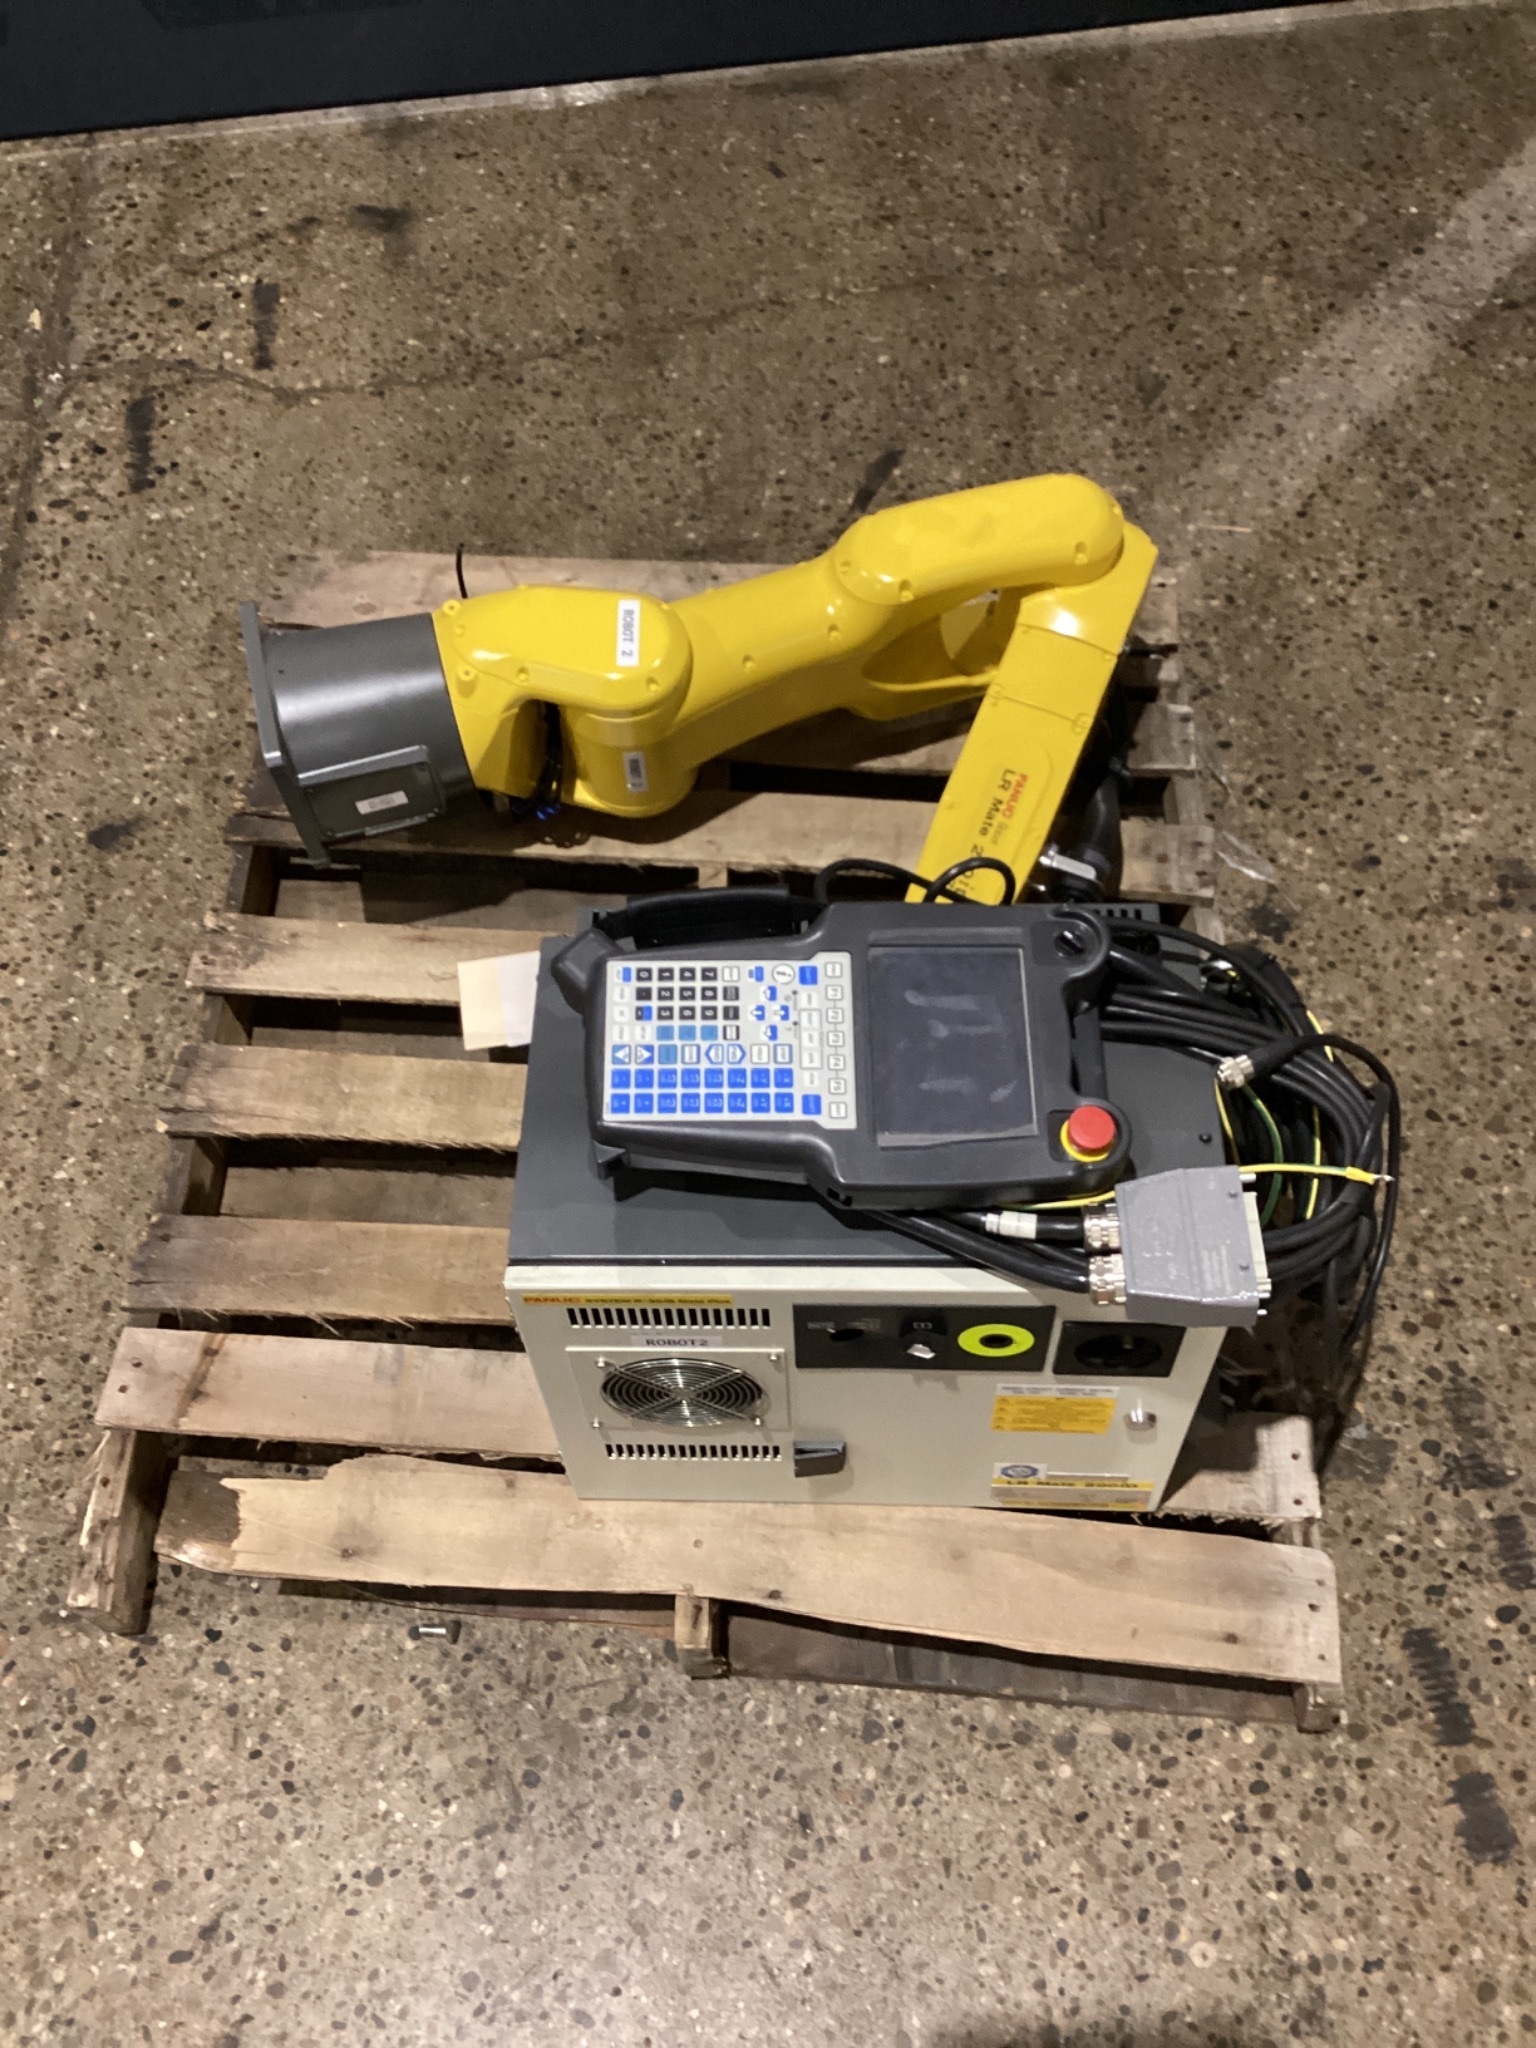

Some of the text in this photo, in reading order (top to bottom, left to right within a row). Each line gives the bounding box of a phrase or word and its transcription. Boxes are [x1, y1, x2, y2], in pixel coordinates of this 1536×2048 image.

[621, 609, 635, 657] ROBOT 2
[998, 769, 1016, 791] LR
[1002, 773, 1029, 819] FANUC
[979, 798, 1004, 837] Mate
[523, 1296, 581, 1304] FANUC
[645, 1338, 709, 1347] ROBOT2
